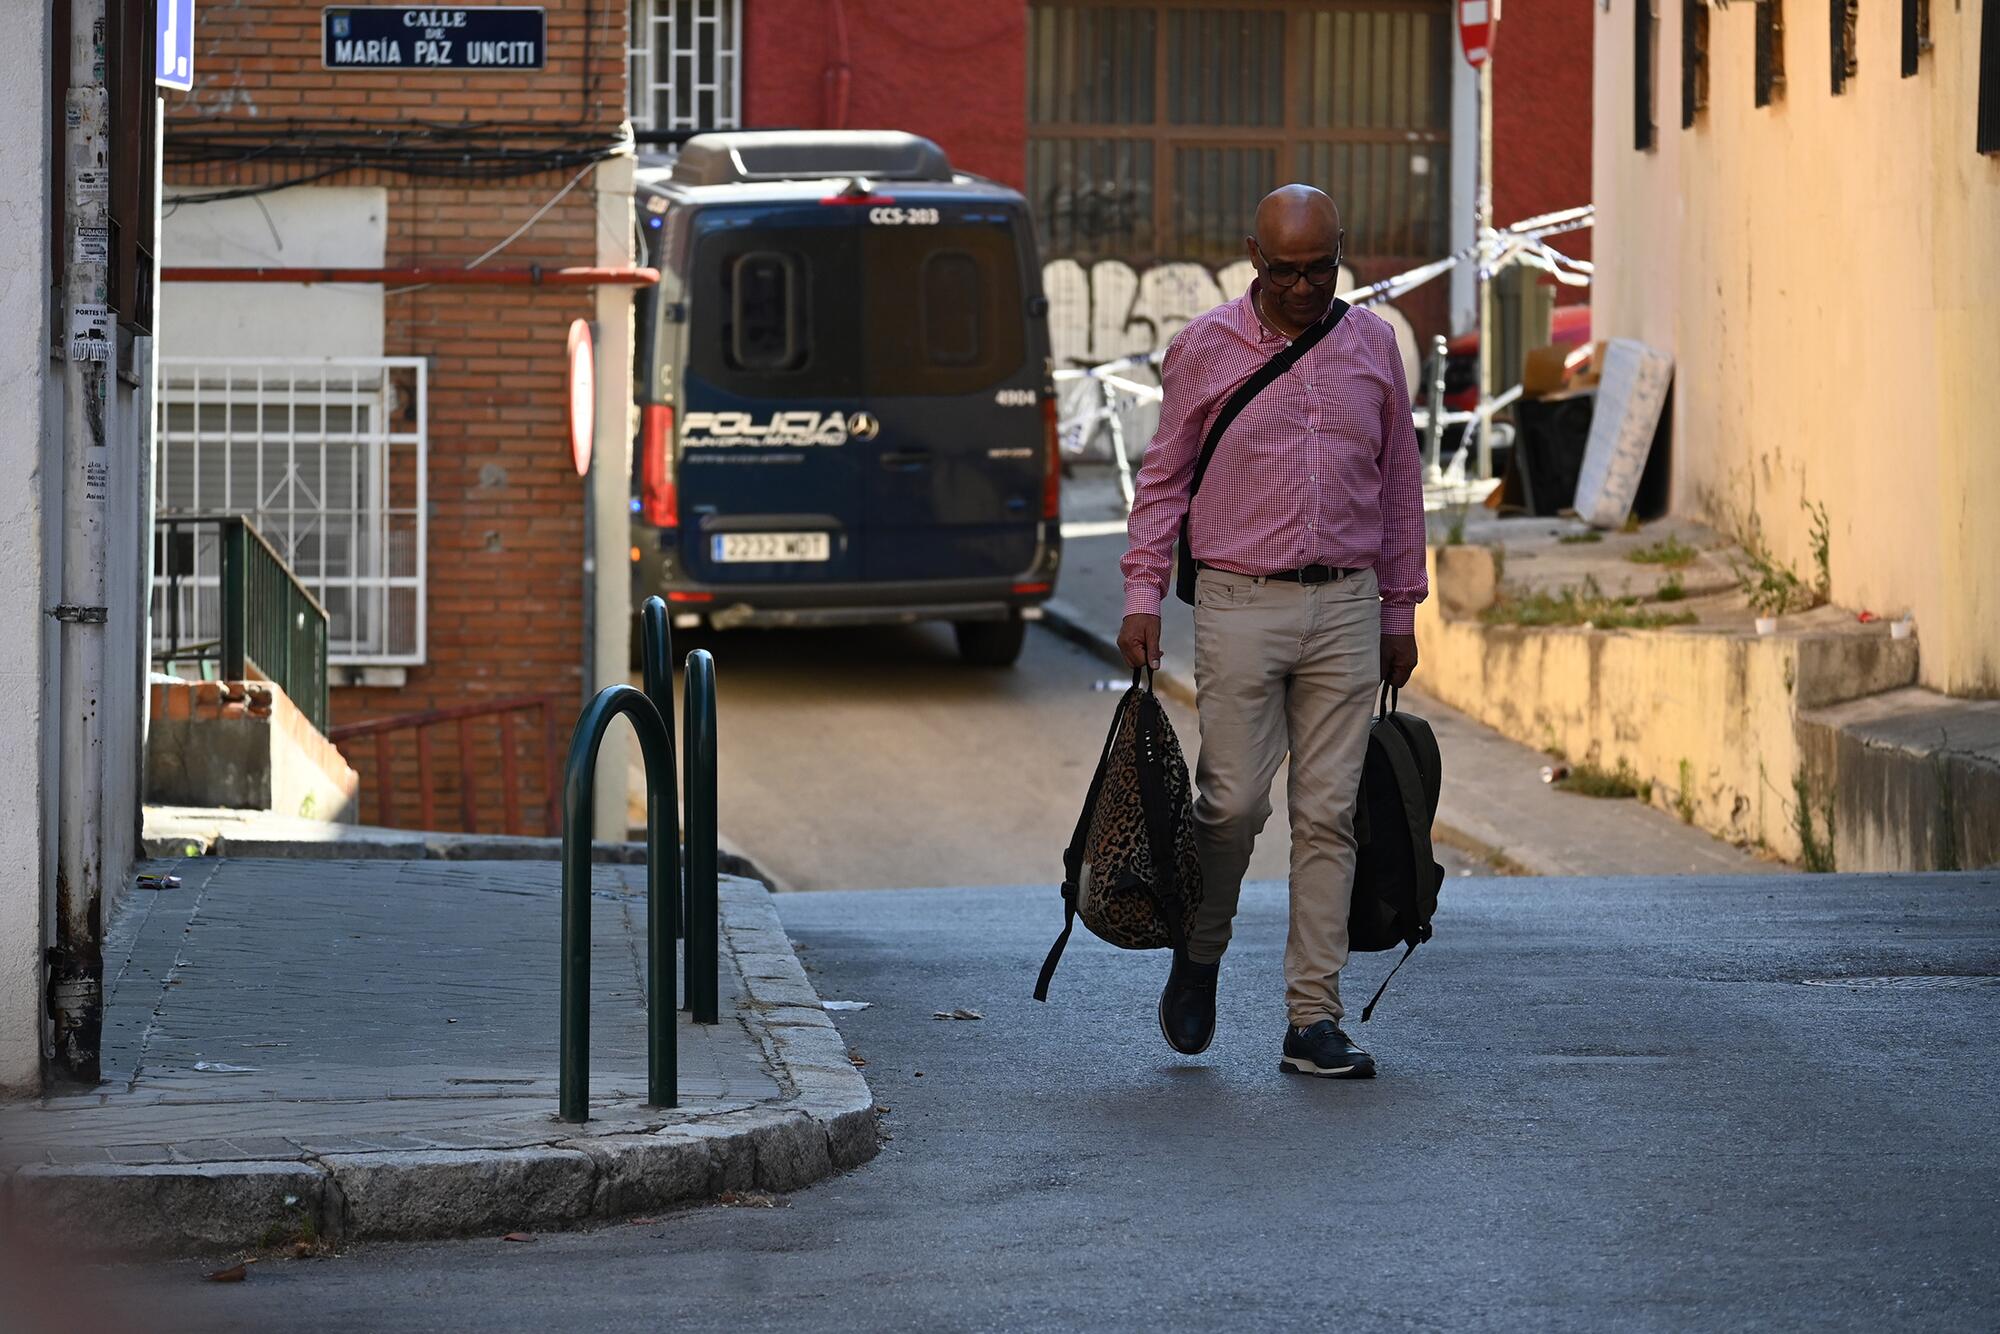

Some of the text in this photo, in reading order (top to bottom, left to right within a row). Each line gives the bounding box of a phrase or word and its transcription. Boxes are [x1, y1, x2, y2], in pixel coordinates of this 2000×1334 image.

[403, 11, 467, 27] CALLE
[425, 28, 445, 40] DE
[335, 37, 535, 65] MARÍA PAZ UNCITI
[869, 207, 940, 225] CCS-203
[995, 389, 1036, 407] 4904
